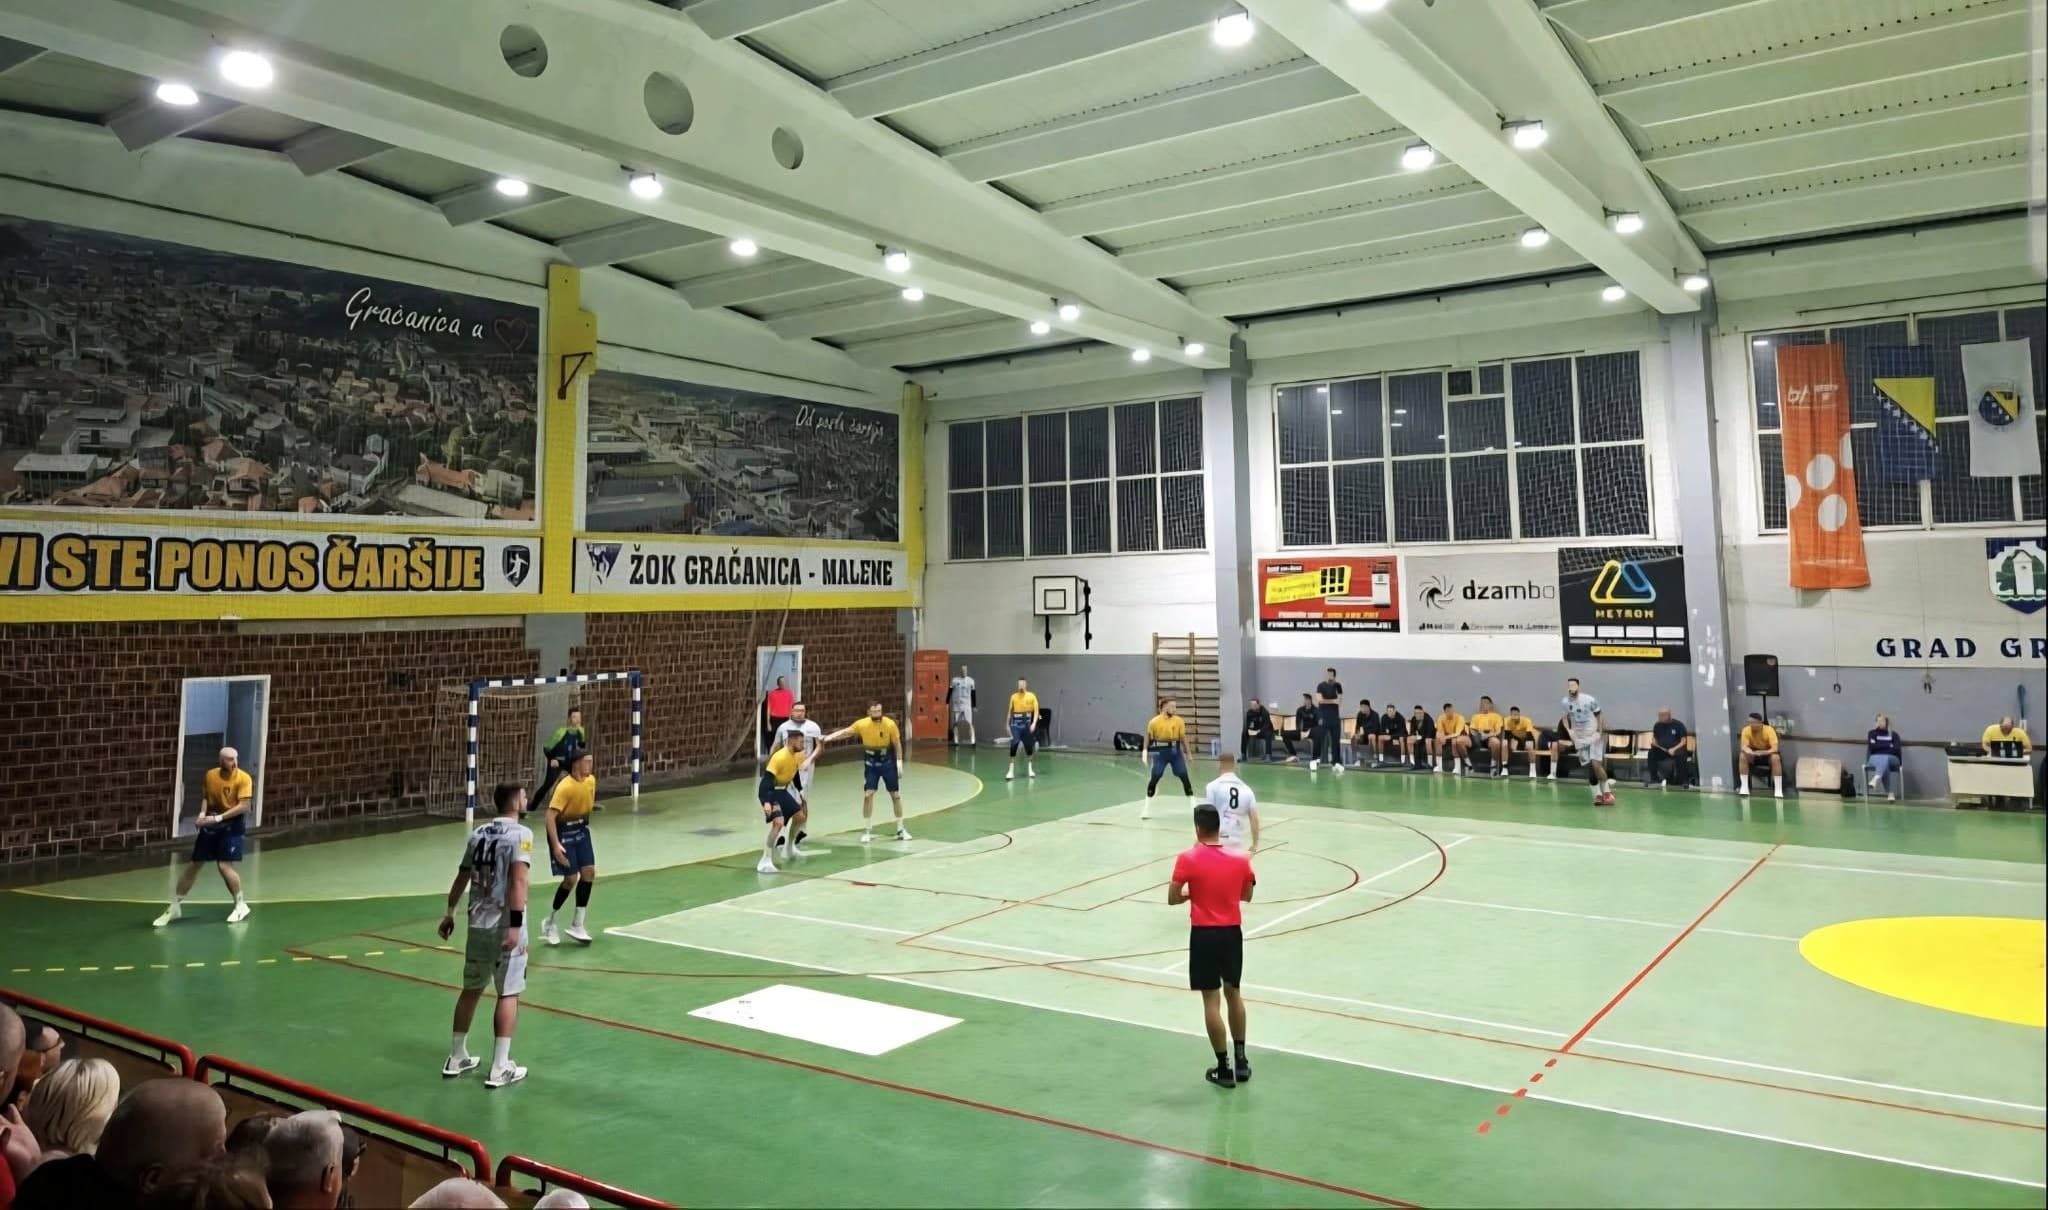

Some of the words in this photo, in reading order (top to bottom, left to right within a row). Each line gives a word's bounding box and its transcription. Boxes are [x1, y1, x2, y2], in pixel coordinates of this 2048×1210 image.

[46, 533, 152, 591] STE
[154, 538, 319, 592] PONOS
[323, 534, 485, 592] ČARŠIJE
[629, 543, 677, 585] ŽOK
[684, 546, 802, 586] GRAČANICA
[822, 558, 893, 586] MALENE
[1462, 579, 1555, 600] dzambo
[1876, 637, 1977, 659] GRAD
[2000, 637, 2047, 659] GR
[1229, 786, 1239, 809] 8
